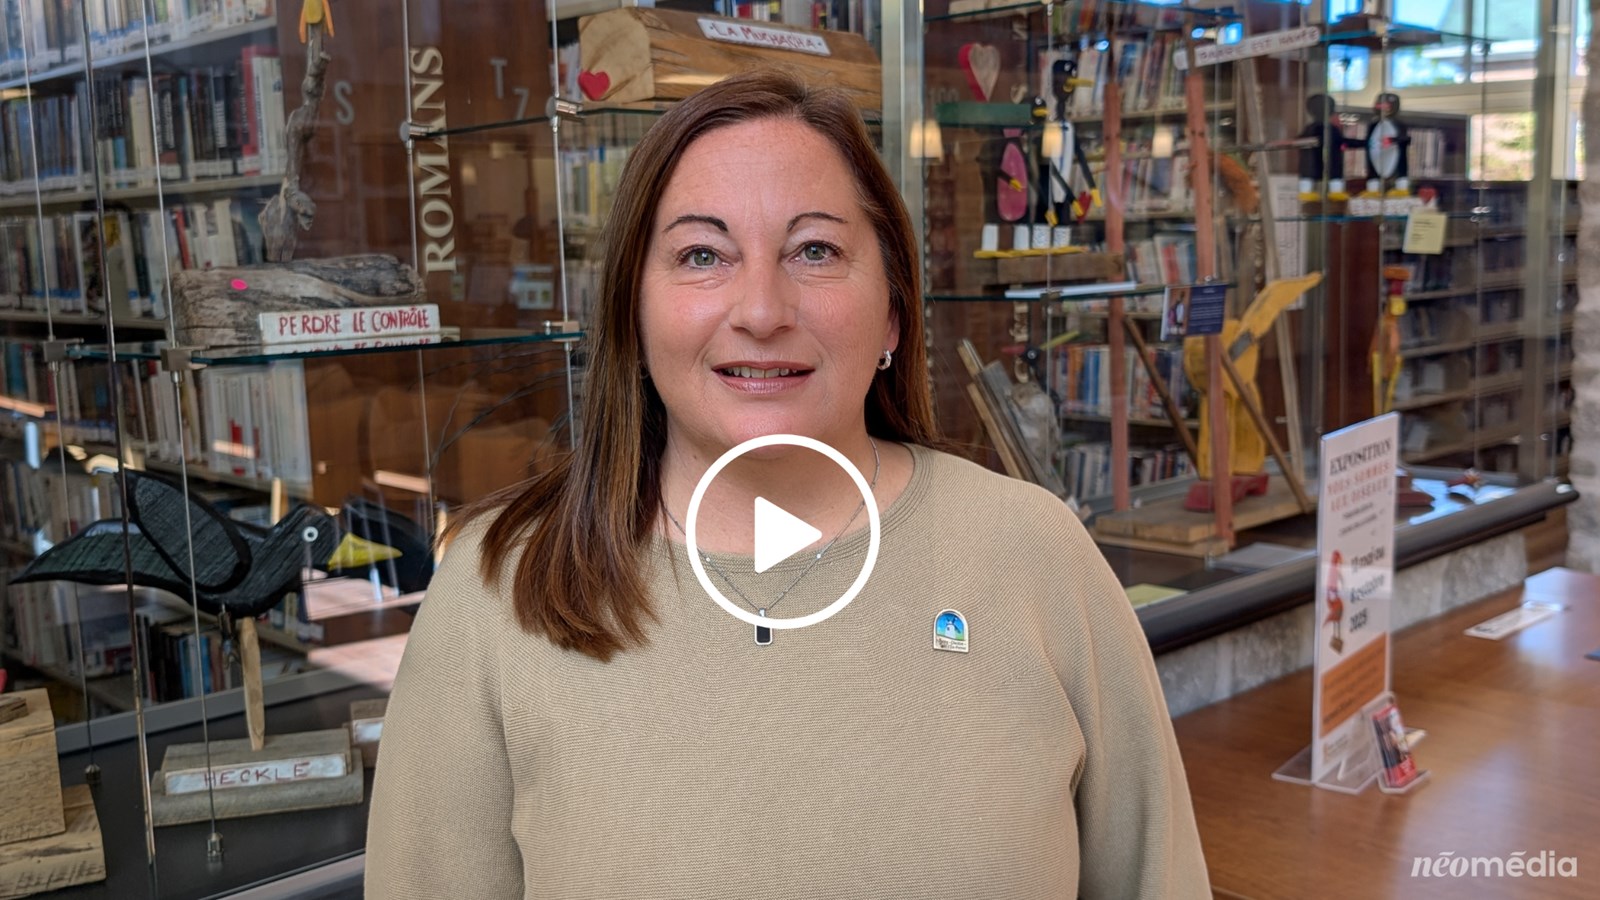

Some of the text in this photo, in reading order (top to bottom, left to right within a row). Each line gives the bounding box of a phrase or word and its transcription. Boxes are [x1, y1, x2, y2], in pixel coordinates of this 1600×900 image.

[711, 22, 737, 37] LA
[333, 80, 355, 125] S
[409, 46, 457, 274] ROMANS
[279, 305, 431, 336] PERDRE LE CONTRÔLE
[1329, 438, 1392, 476] EXPOSITION
[203, 761, 311, 787] HECKLE
